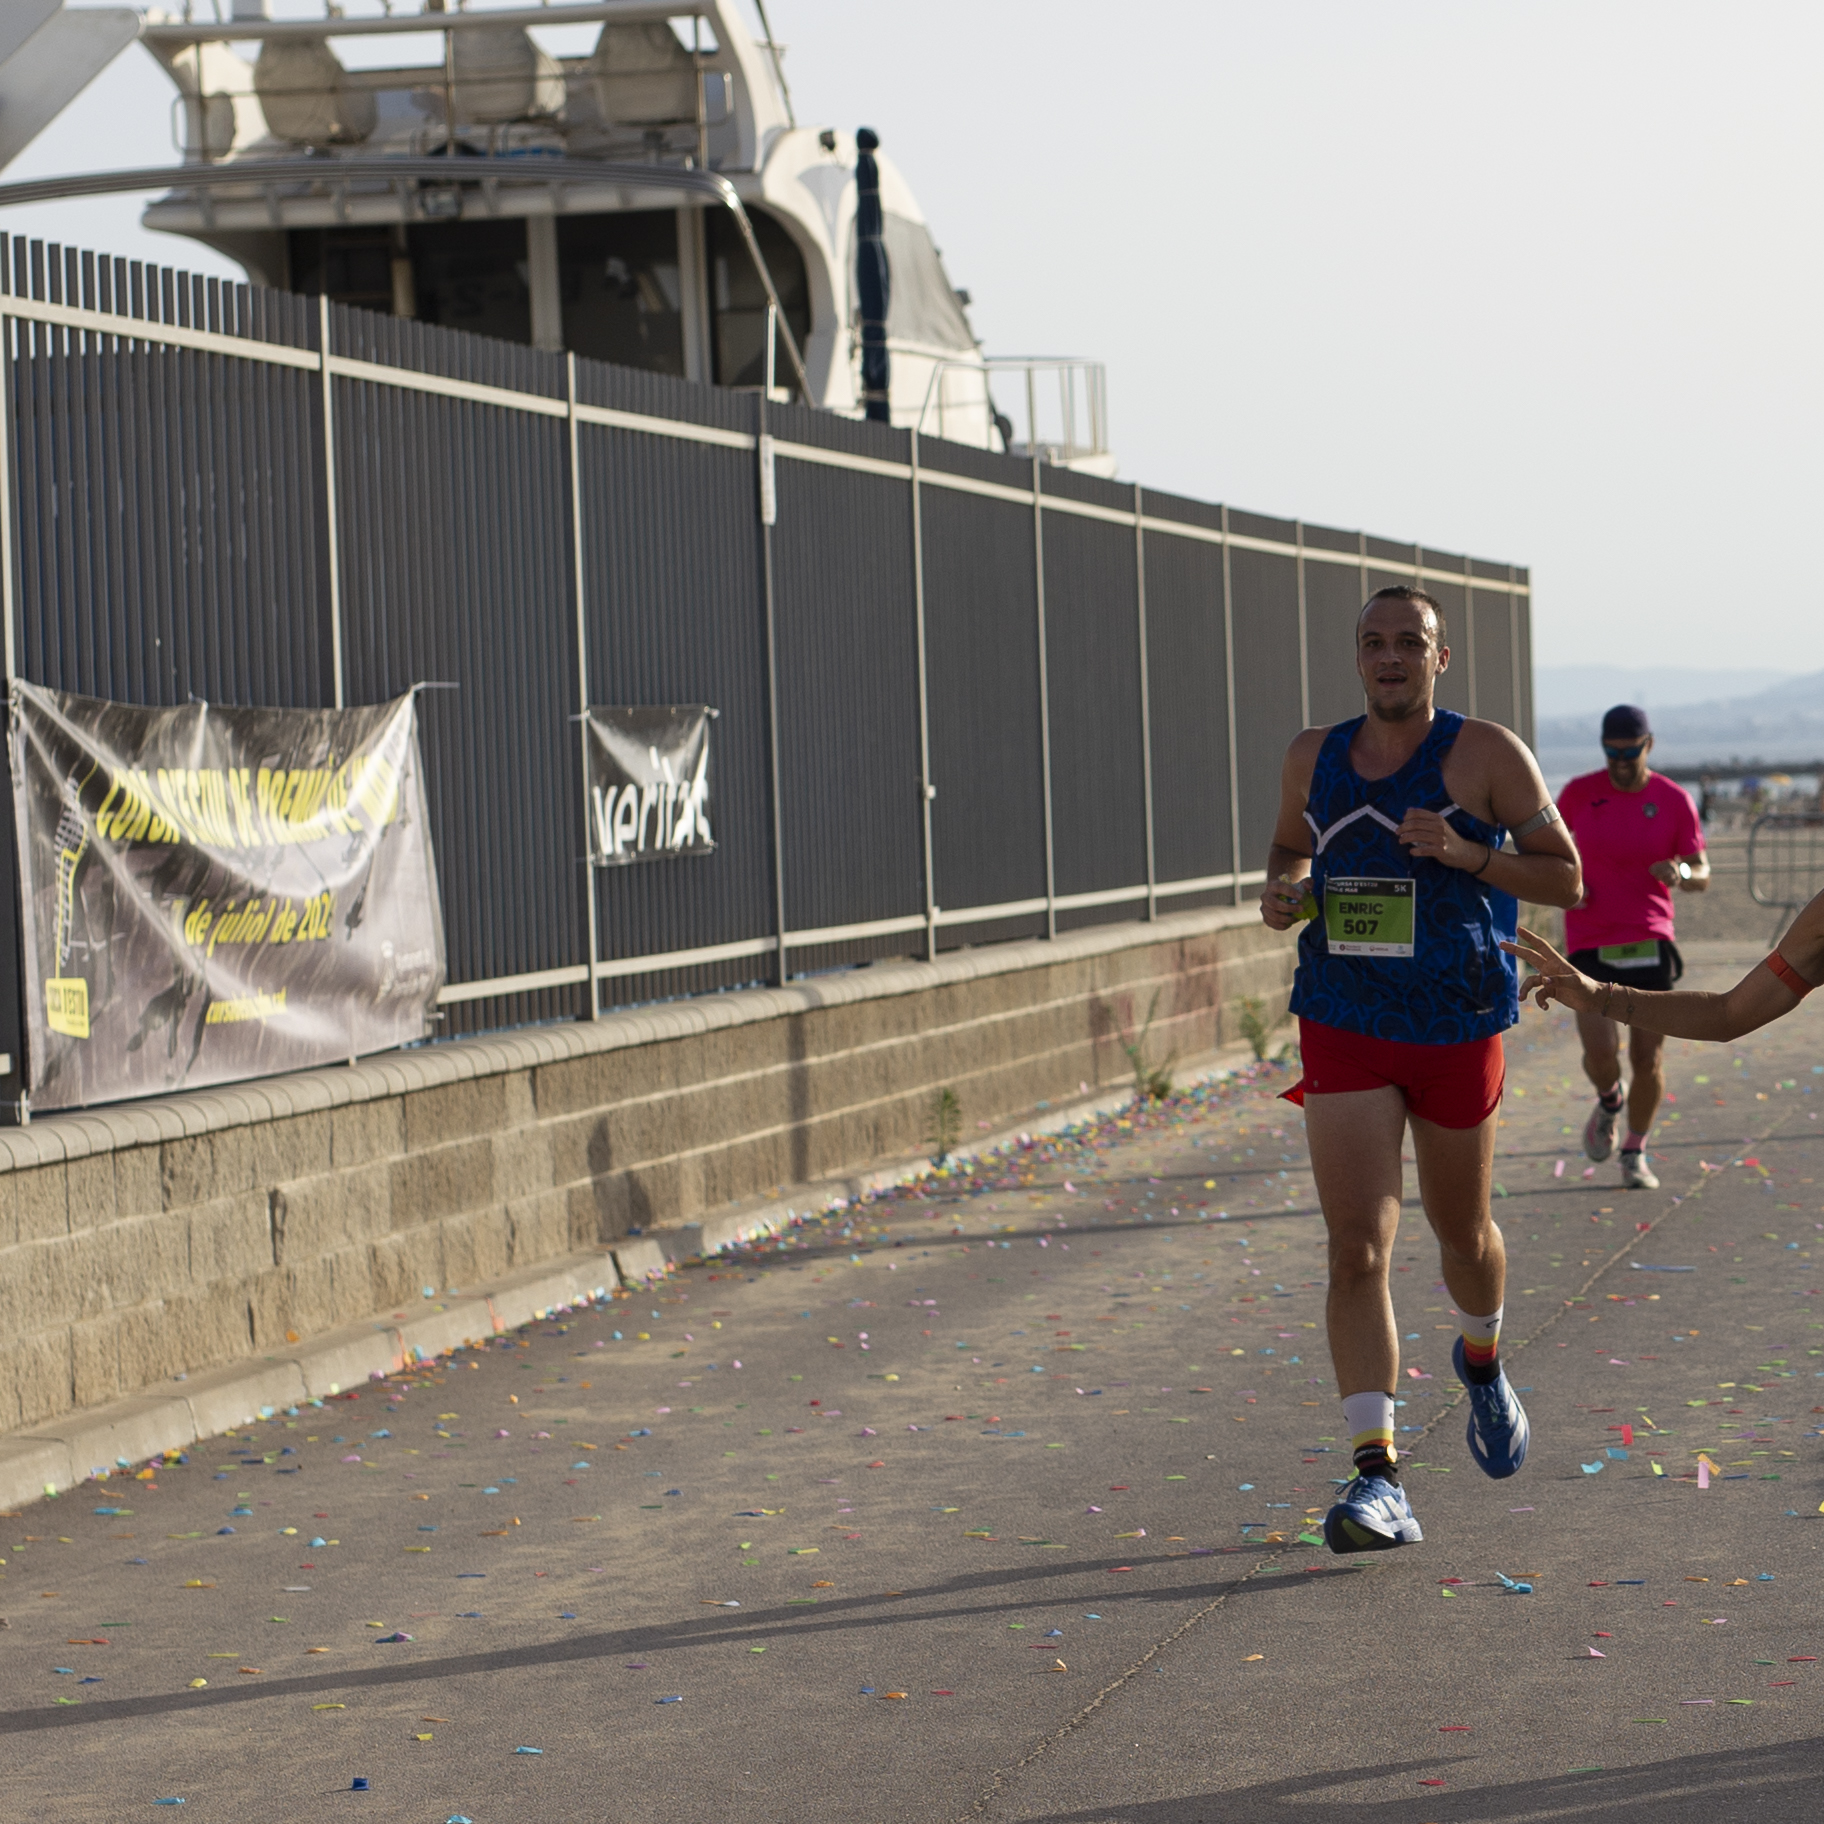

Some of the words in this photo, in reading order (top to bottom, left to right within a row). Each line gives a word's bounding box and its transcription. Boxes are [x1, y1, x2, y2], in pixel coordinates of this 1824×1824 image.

[1394, 884, 1407, 893] 5K
[1339, 902, 1384, 915] ENRIC
[185, 898, 213, 946] de
[207, 897, 277, 958] juliol
[269, 897, 298, 945] de
[297, 891, 337, 943] 202
[1343, 919, 1379, 935] 507
